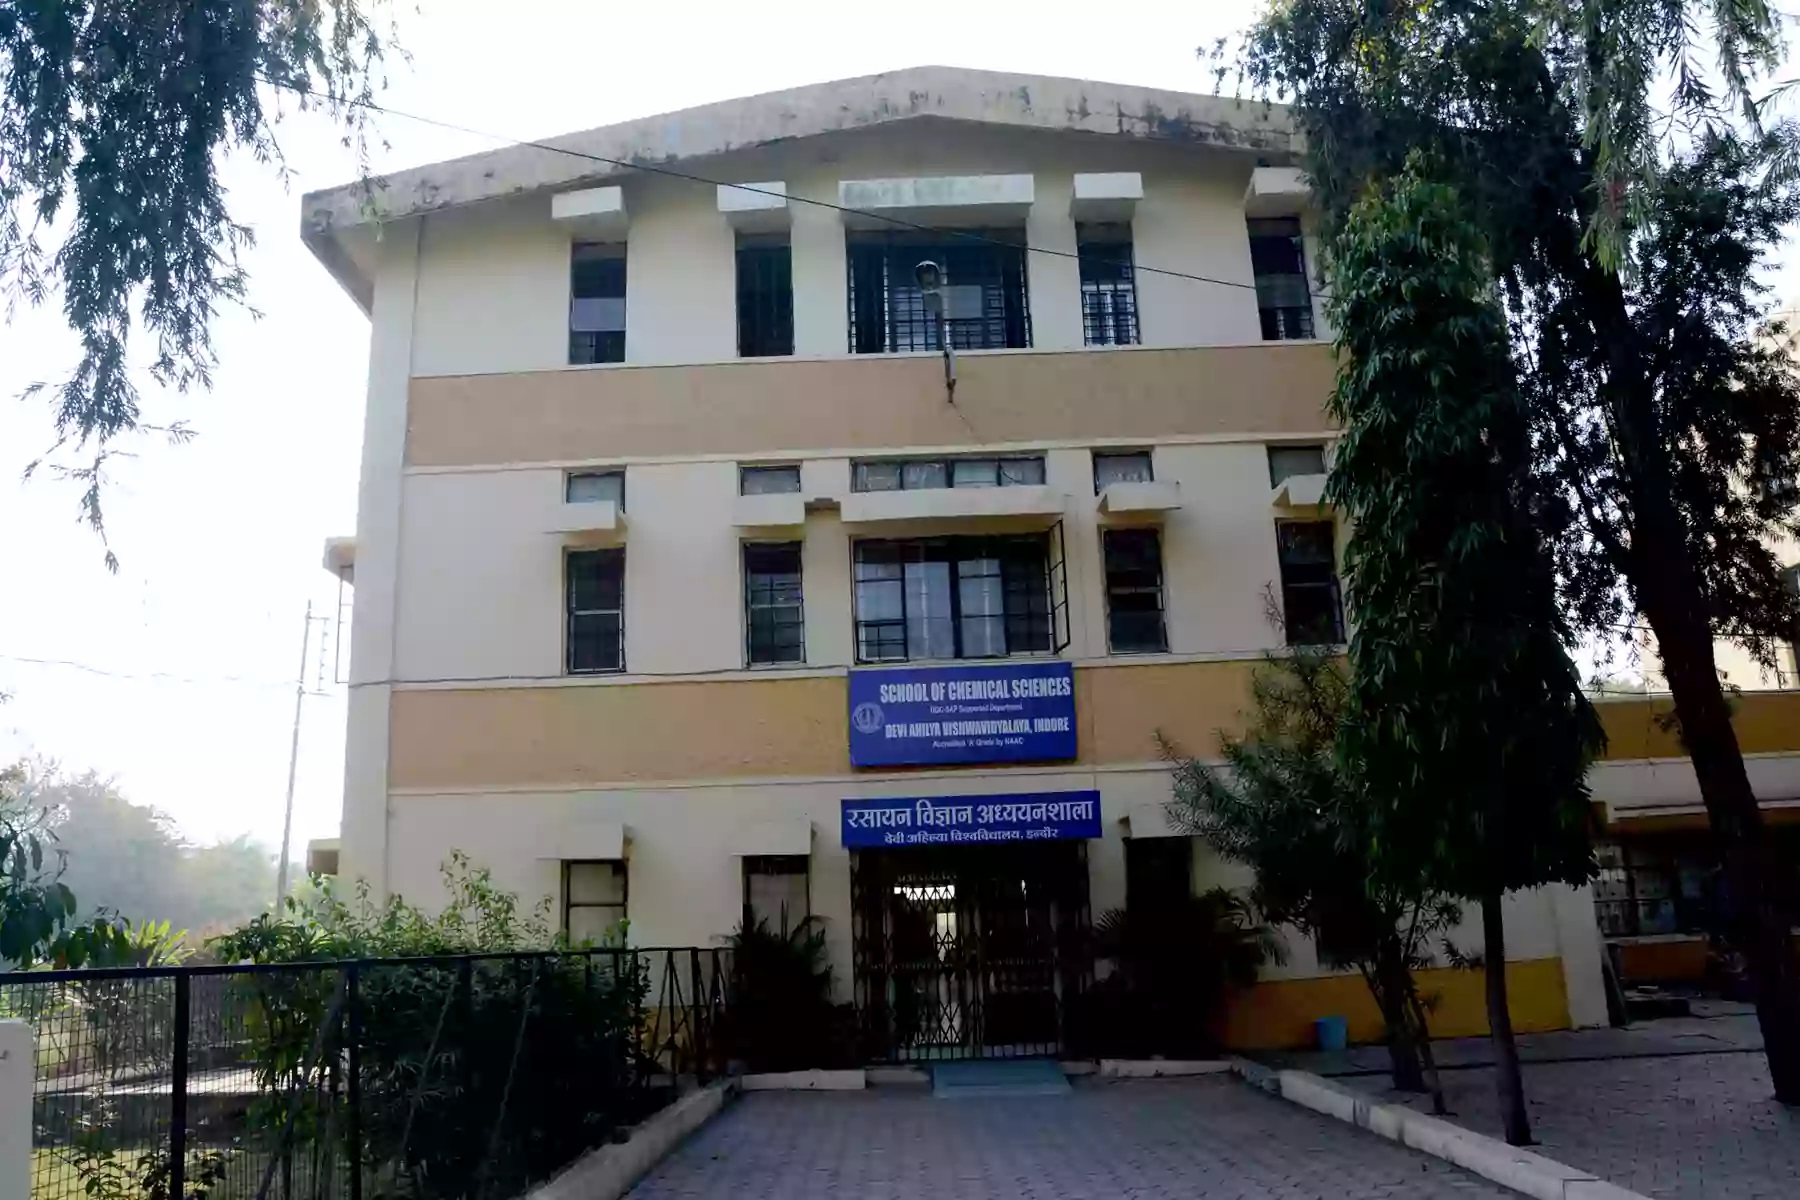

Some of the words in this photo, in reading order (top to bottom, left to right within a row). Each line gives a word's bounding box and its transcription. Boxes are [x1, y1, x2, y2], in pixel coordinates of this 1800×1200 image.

[880, 684, 929, 703] SCHOOL
[931, 682, 946, 701] OF
[948, 679, 1010, 700] CHEMICAL
[1012, 677, 1071, 698] SCIENCES
[885, 723, 908, 738] DEVI
[909, 722, 941, 737] AHILYA
[1034, 717, 1069, 733] INDORE
[1005, 737, 1025, 745] NAAC
[846, 808, 911, 828] रसायन
[914, 800, 973, 827] विज्ञान
[977, 801, 1094, 824] अध्ययनशाला
[884, 831, 905, 844] देवी
[906, 830, 948, 844] अहिल्या
